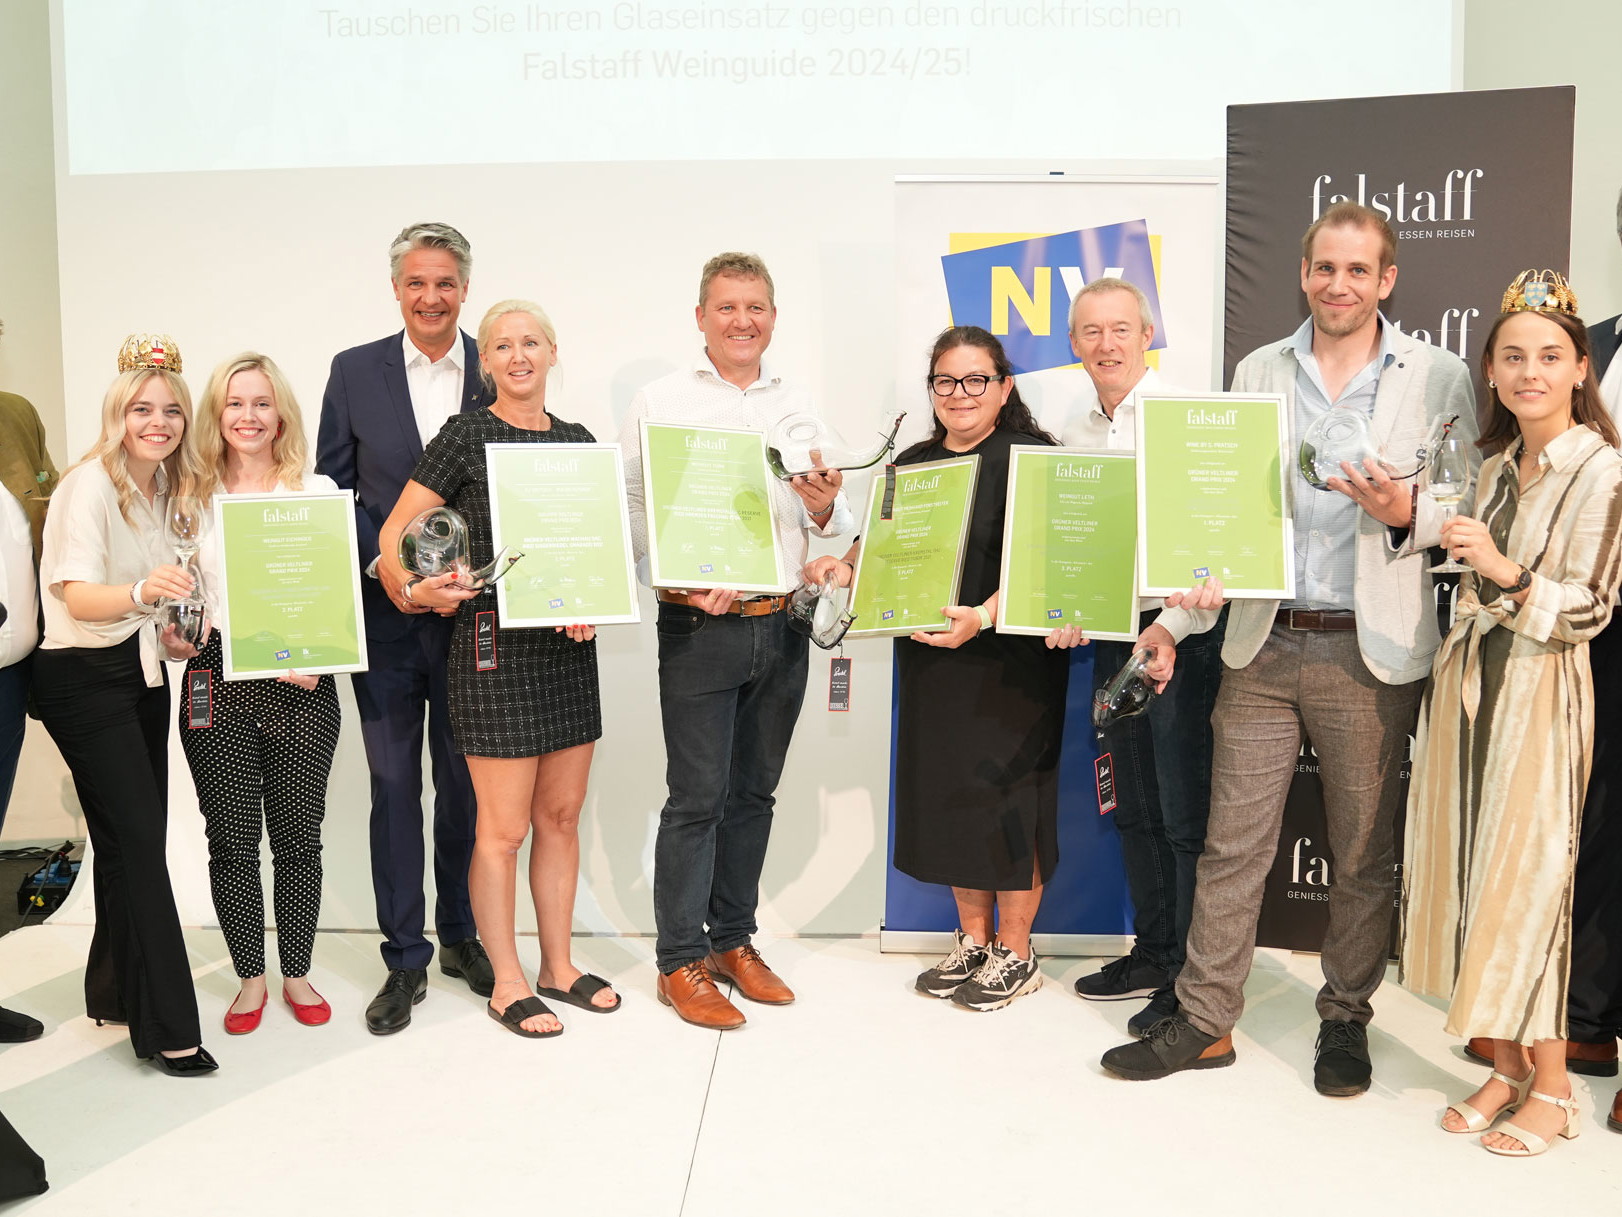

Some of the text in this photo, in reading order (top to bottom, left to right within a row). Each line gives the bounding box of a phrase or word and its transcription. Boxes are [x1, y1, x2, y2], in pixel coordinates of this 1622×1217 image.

[319, 0, 1182, 38] Tauschen Sie Ihren Glaseinsatz gegen den druckfrischen
[523, 46, 972, 85] Falstaff Weinguide 2024/25!
[1308, 168, 1484, 226] flstaff
[1399, 229, 1475, 240] ESSEN REISEN
[1187, 408, 1238, 425] falstaff
[685, 435, 729, 450] falstaff
[1056, 462, 1103, 479] falstaff
[904, 474, 942, 493] falstaff
[263, 506, 310, 523] falstaff
[1295, 764, 1320, 774] GENIE
[1287, 890, 1329, 902] GENIESS
